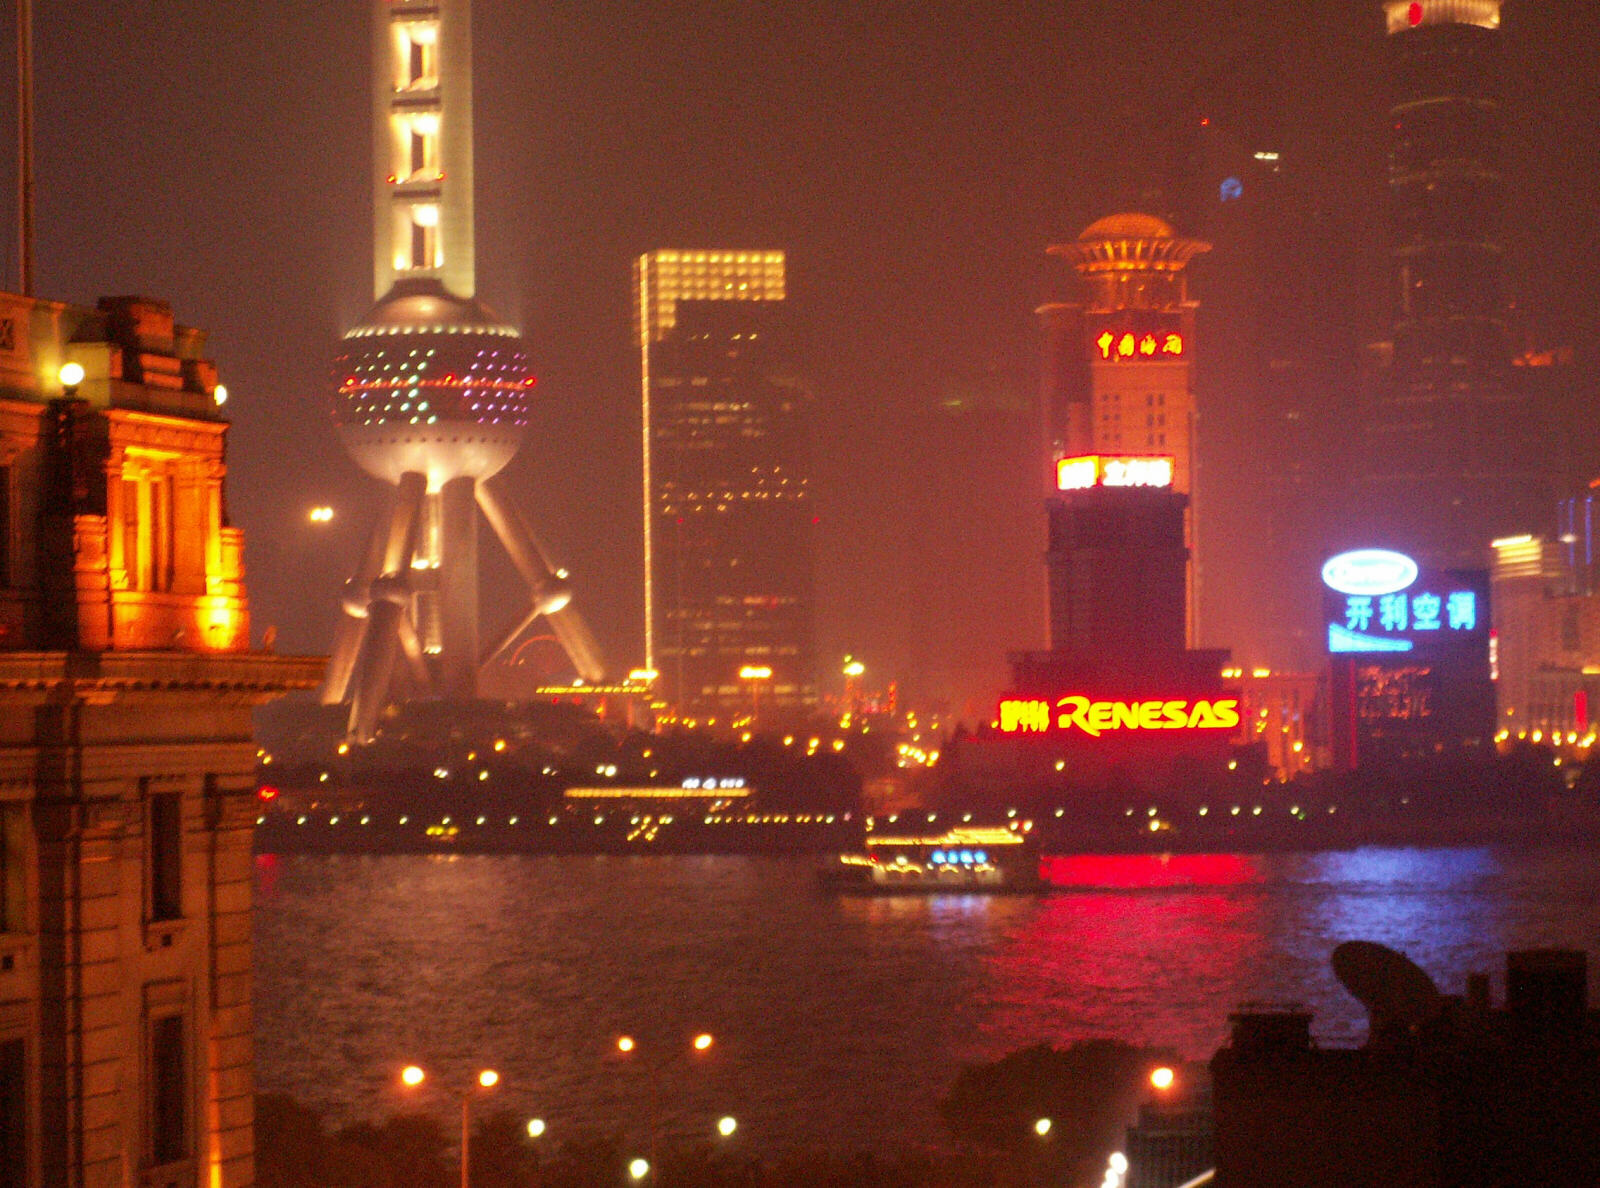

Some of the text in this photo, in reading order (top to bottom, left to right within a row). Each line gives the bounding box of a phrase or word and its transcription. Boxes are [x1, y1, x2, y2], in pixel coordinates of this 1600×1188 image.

[1345, 592, 1476, 631] 开利空调
[1057, 695, 1240, 737] RENESAS
